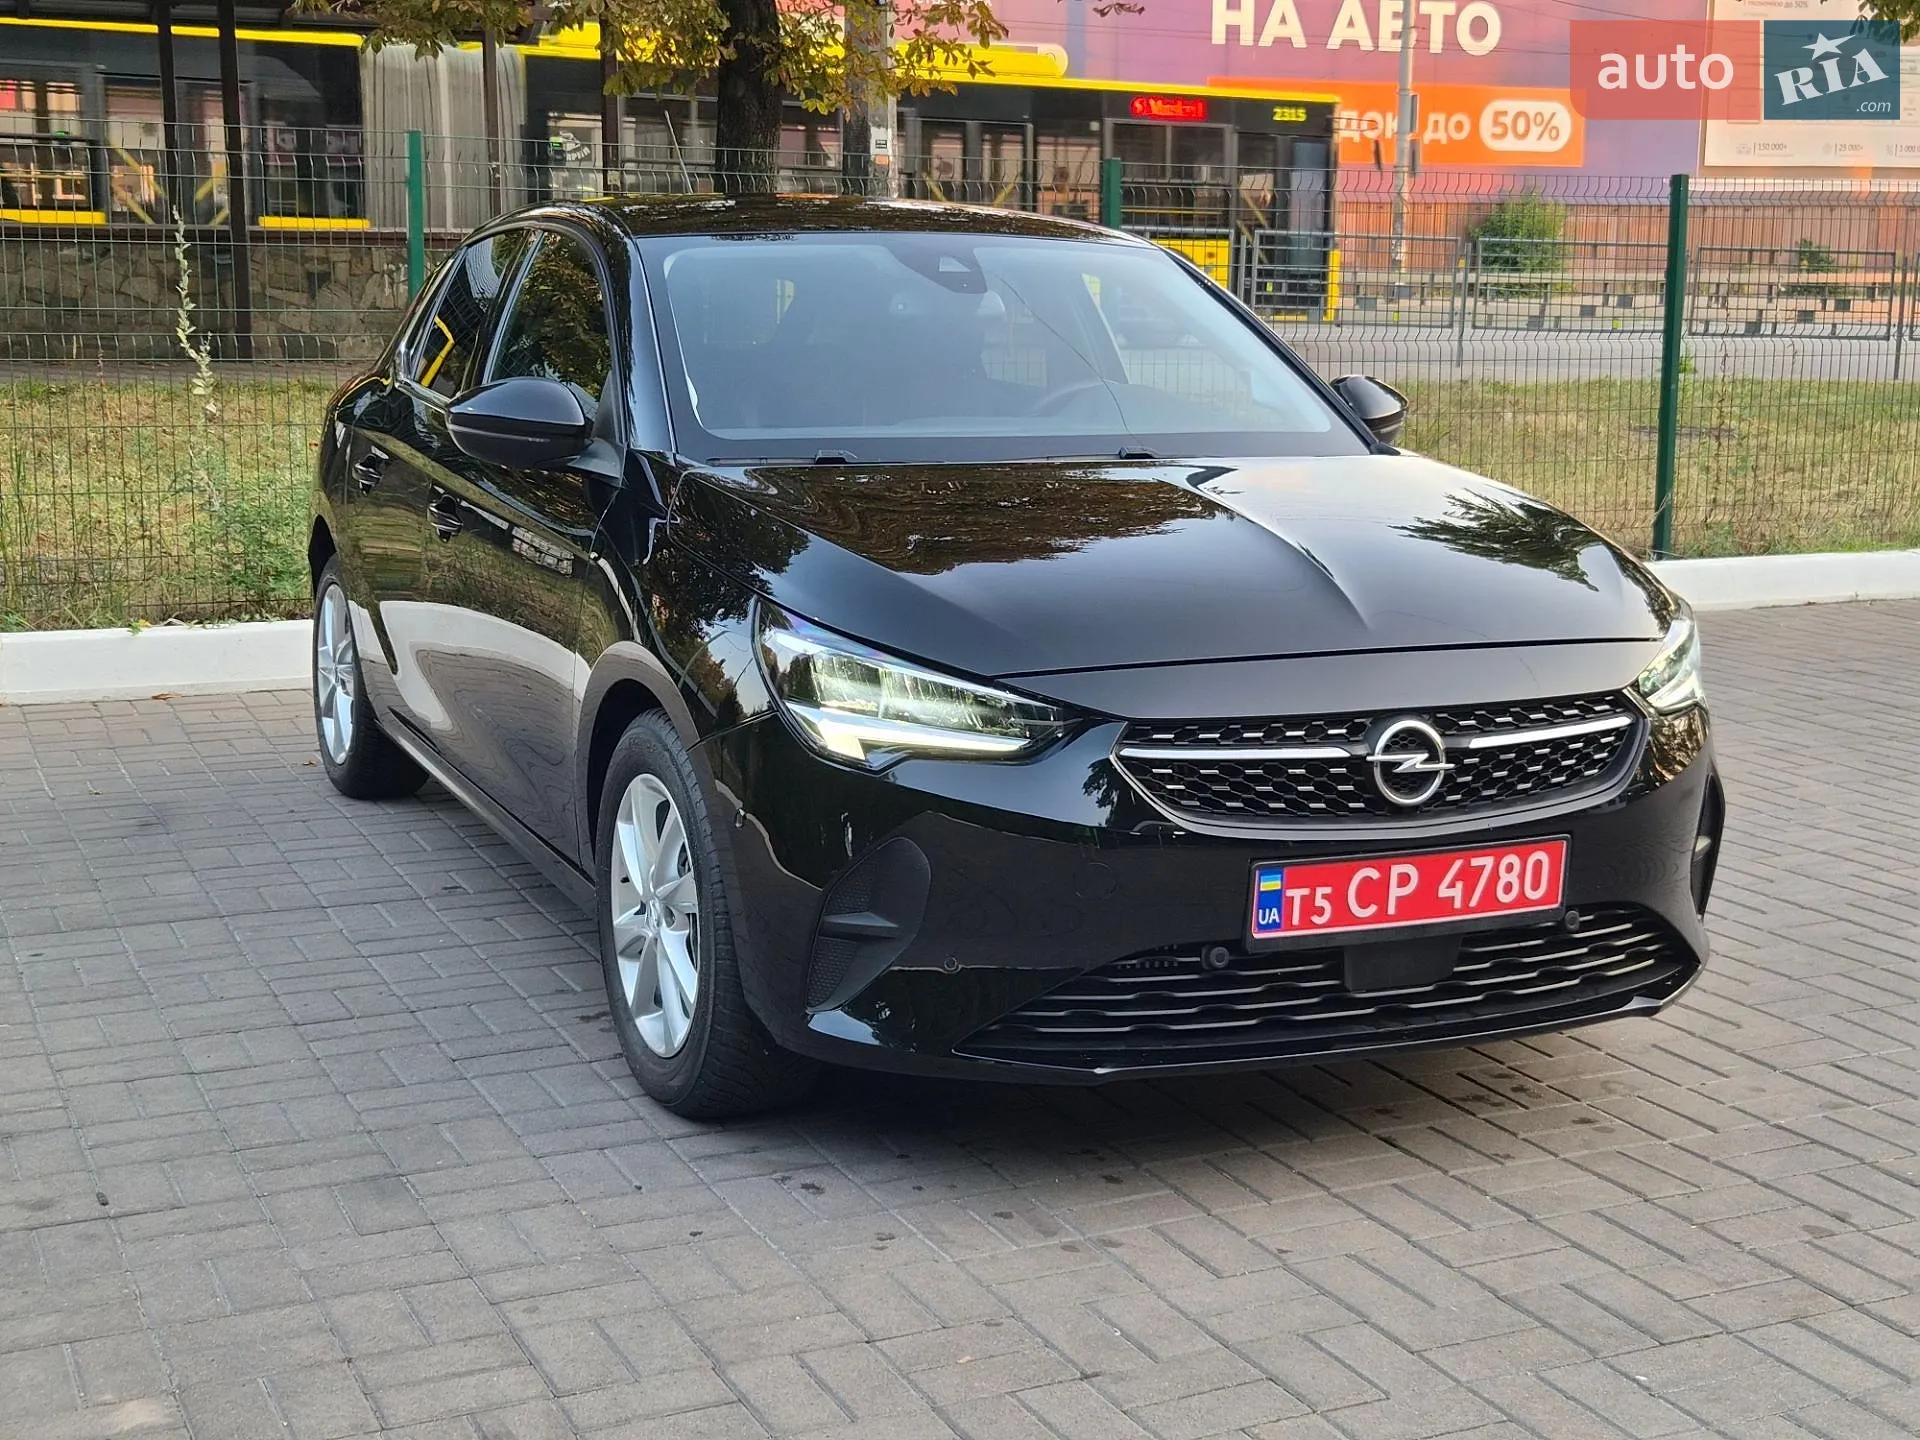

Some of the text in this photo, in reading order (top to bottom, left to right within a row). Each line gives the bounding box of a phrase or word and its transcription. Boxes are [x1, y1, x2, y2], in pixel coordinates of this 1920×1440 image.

[1211, 0, 1307, 48] НА
[1423, 112, 1471, 145] до
[1490, 110, 1560, 142] 50%
[1285, 850, 1550, 926] T5 CP 4780
[1257, 907, 1281, 925] UA
